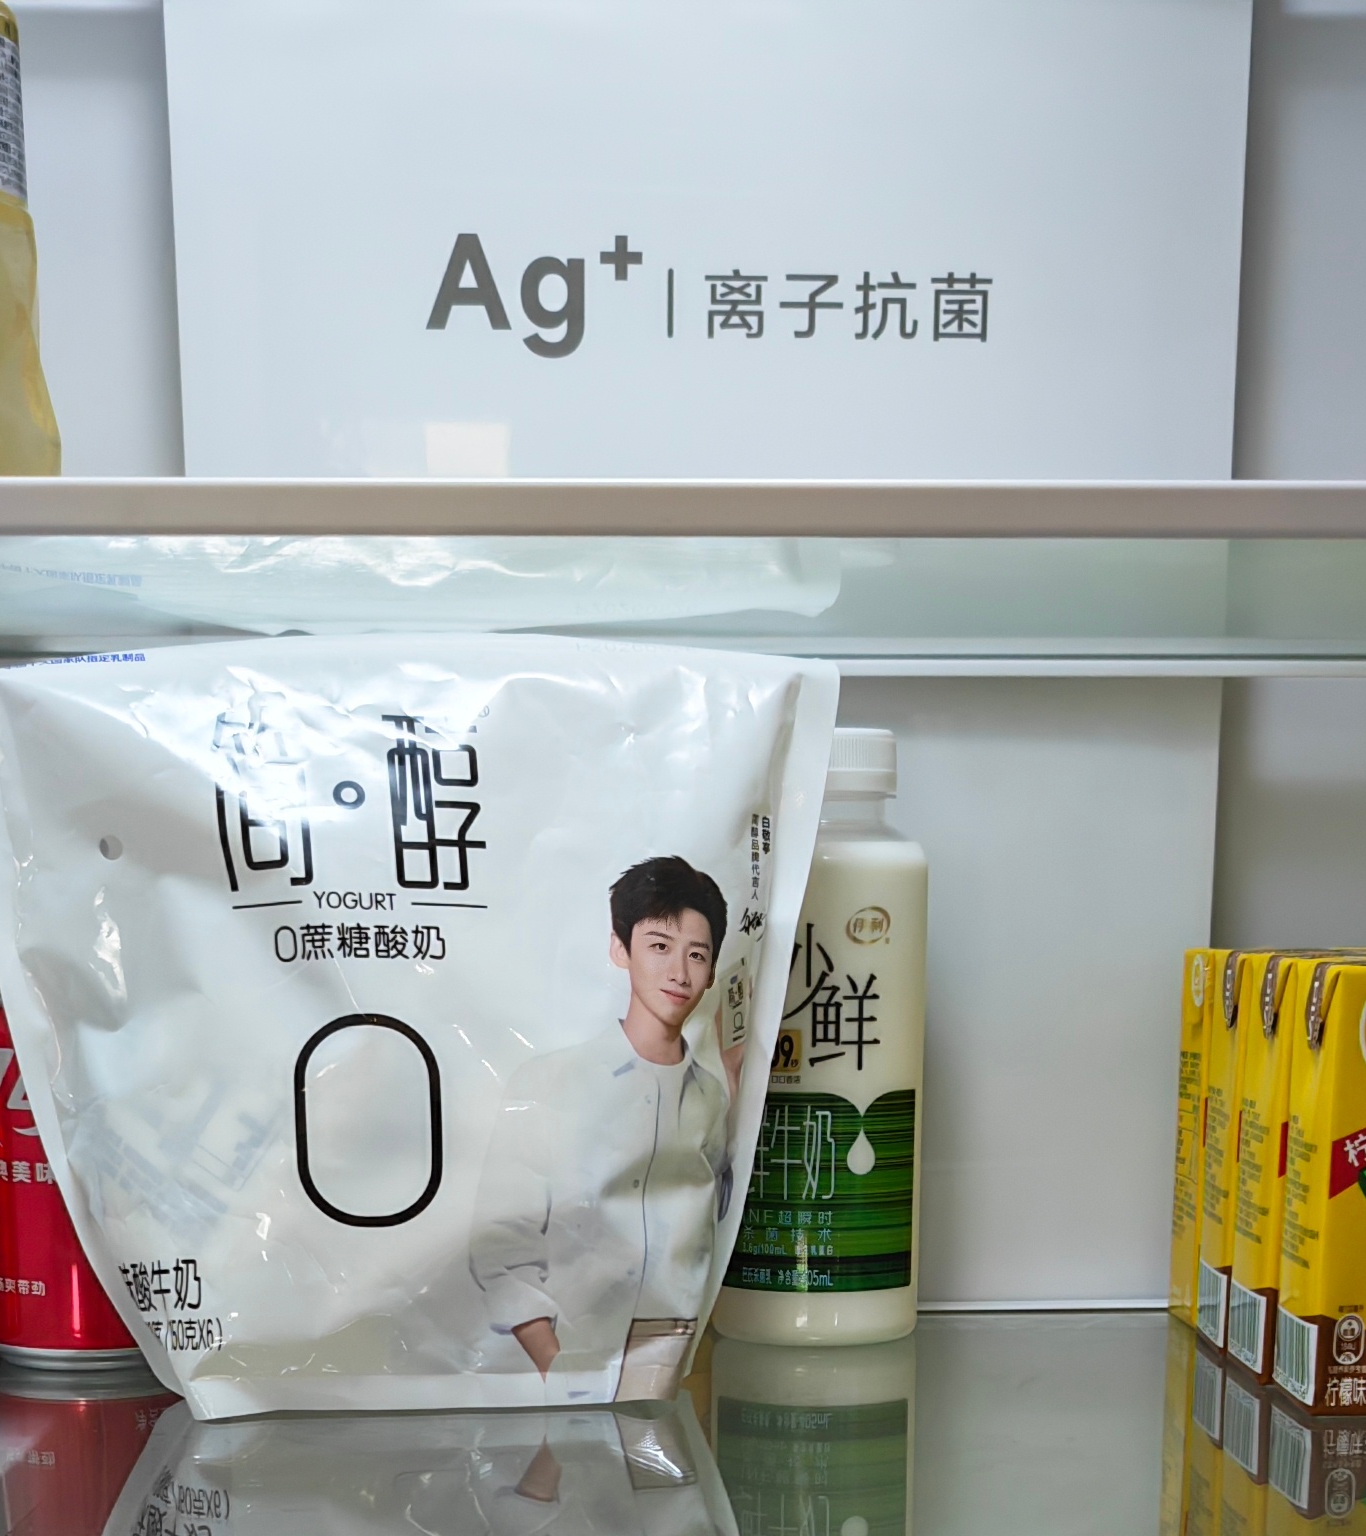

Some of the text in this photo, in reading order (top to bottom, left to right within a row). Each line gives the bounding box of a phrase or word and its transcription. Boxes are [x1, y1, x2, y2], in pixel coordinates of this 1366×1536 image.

[703, 268, 994, 342] 离子抗菌
[312, 890, 397, 911] YOGURT
[274, 922, 447, 963] 0蔗糖酸奶
